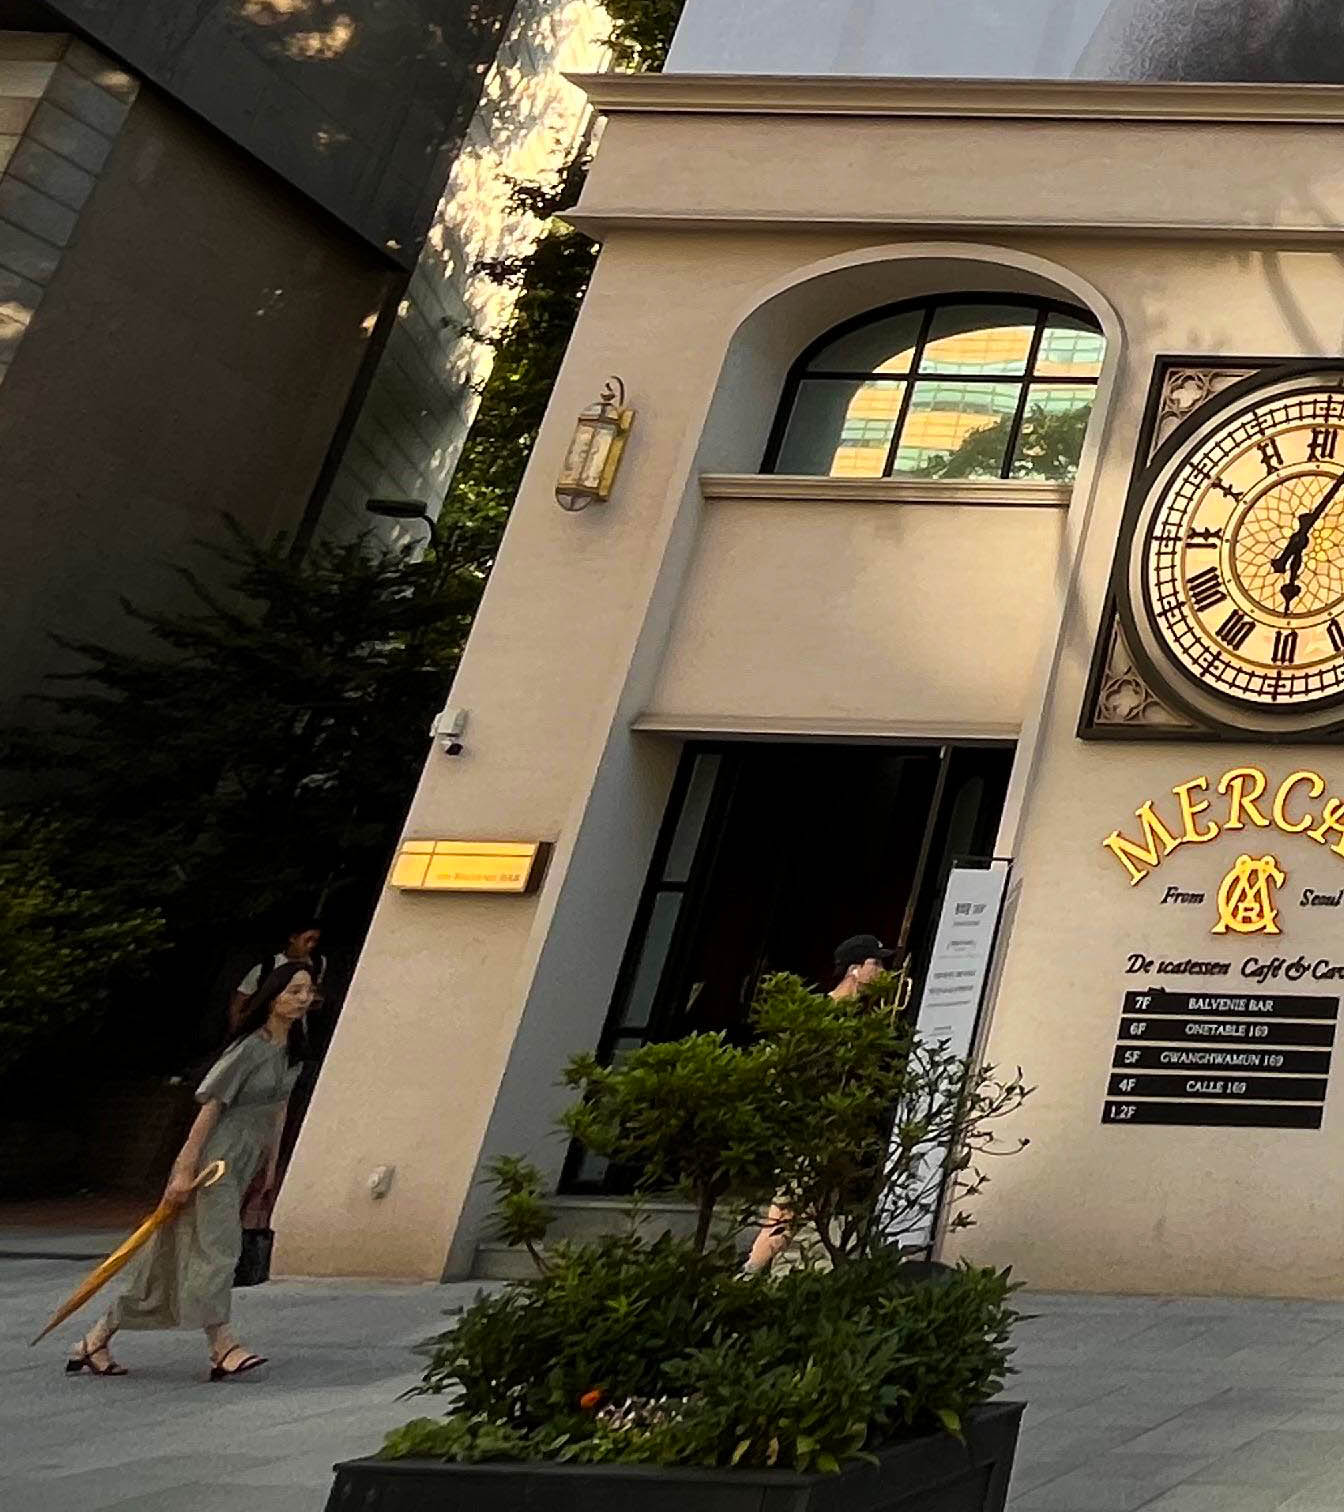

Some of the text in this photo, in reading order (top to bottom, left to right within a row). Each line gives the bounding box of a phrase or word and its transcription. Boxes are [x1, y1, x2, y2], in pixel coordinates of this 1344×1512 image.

[1160, 886, 1344, 908] From Seoul
[1284, 955, 1312, 981] &
[1134, 996, 1274, 1012] 7F BALVENIE BAR
[1130, 1022, 1269, 1037] 6F ONETABLE 169
[1124, 1050, 1284, 1067] 5F GWANGHWAMUN 169
[1118, 1078, 1136, 1092] 4F
[1186, 1080, 1223, 1093] CALLE
